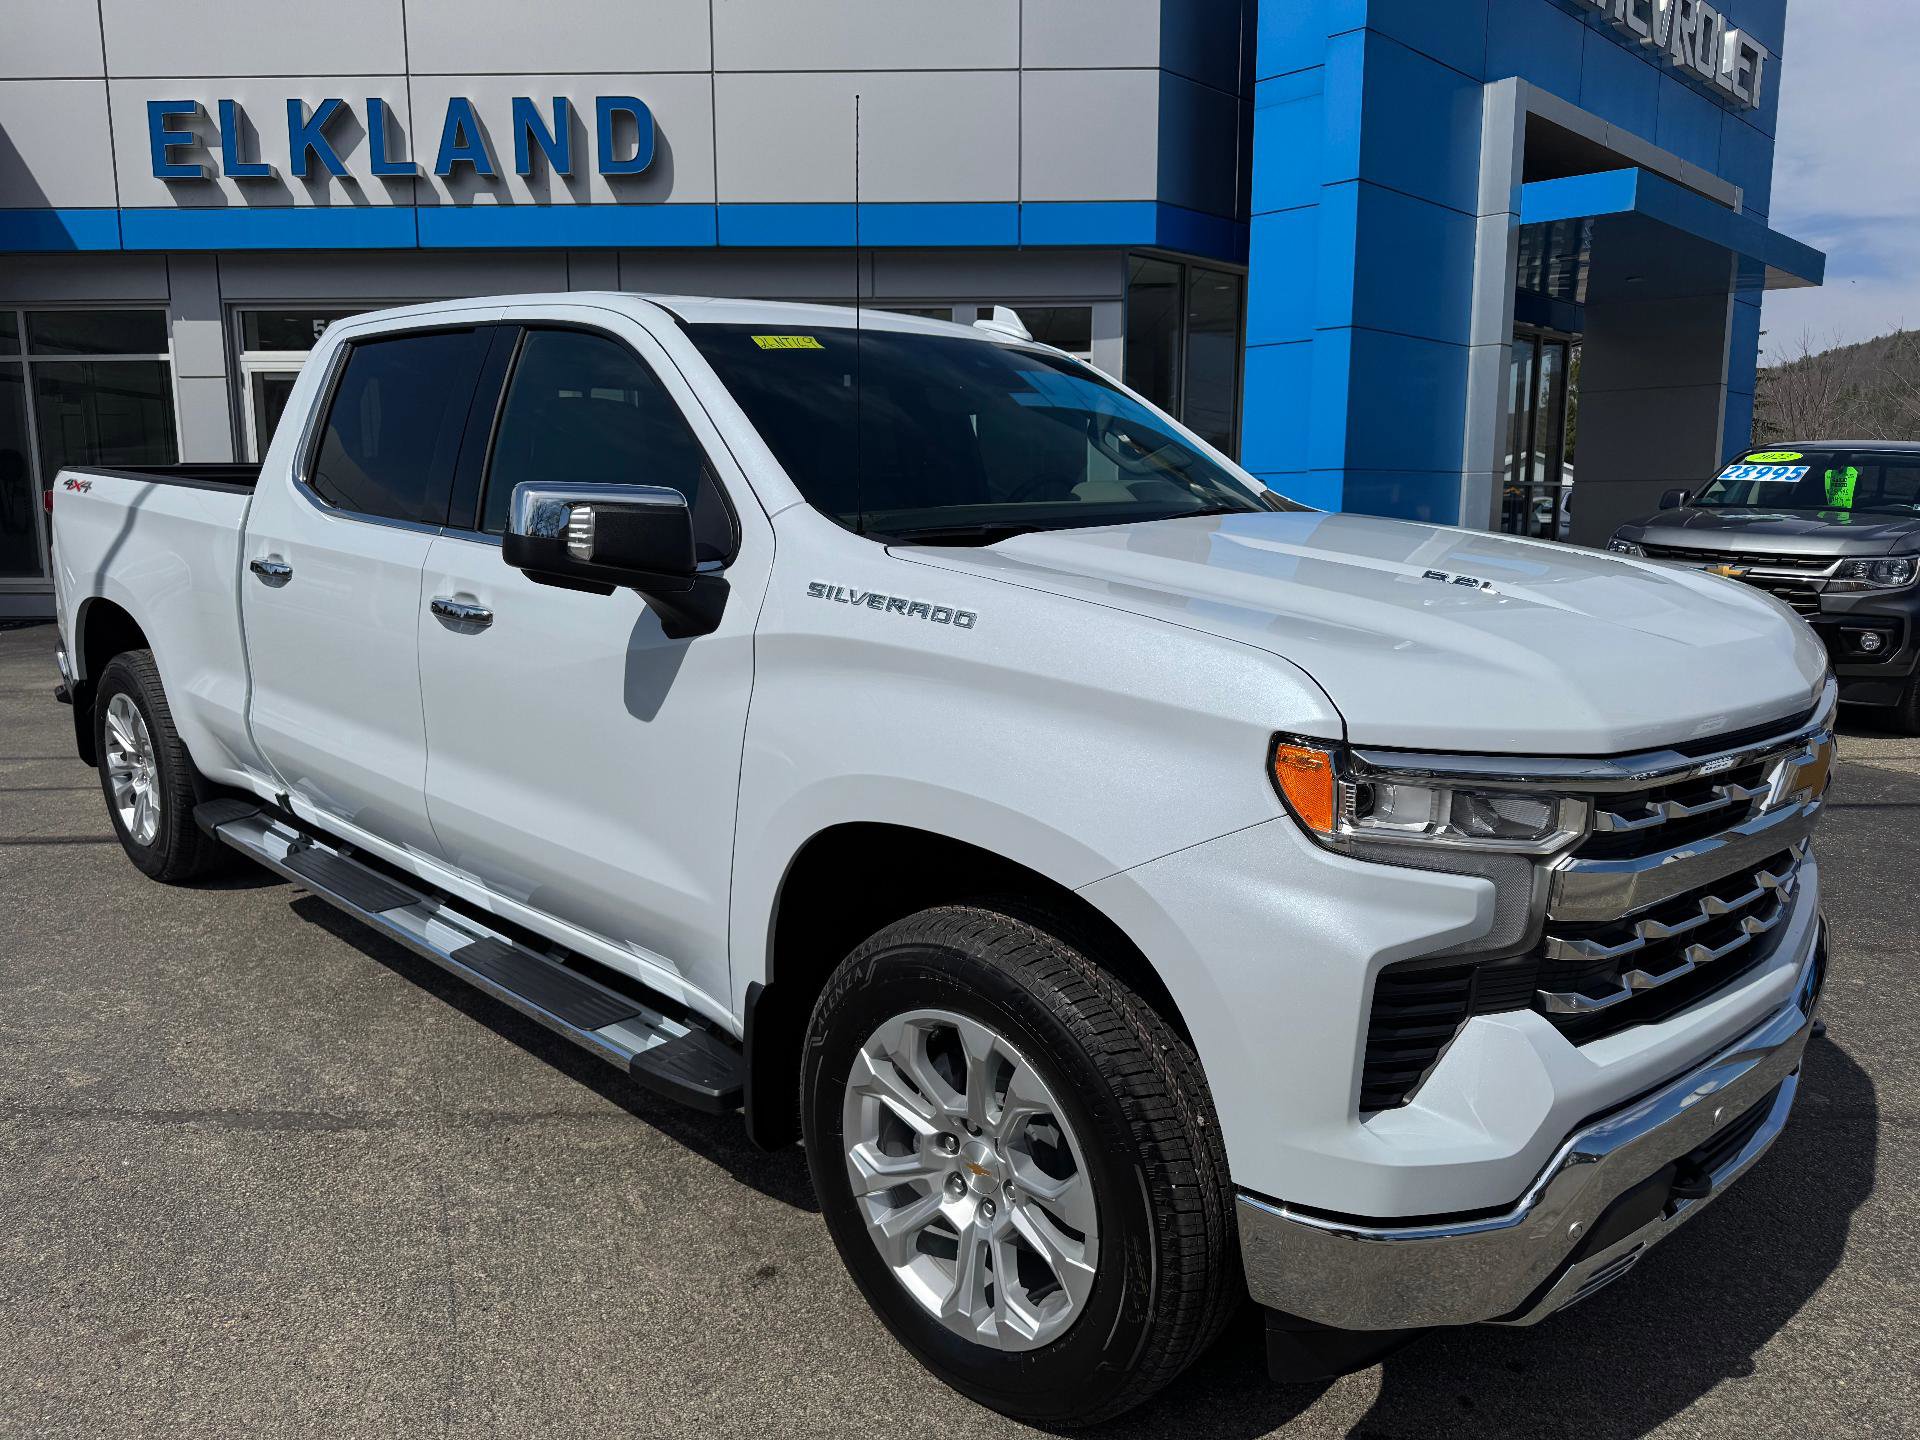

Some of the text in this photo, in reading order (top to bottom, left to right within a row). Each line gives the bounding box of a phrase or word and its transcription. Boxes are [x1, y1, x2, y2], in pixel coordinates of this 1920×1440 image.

[1580, 0, 1767, 109] VROLET
[147, 96, 656, 180] ELKLAND
[1719, 465, 1807, 481] 28995
[807, 581, 978, 630] SILVERADO
[816, 965, 864, 1034] ALENZA
